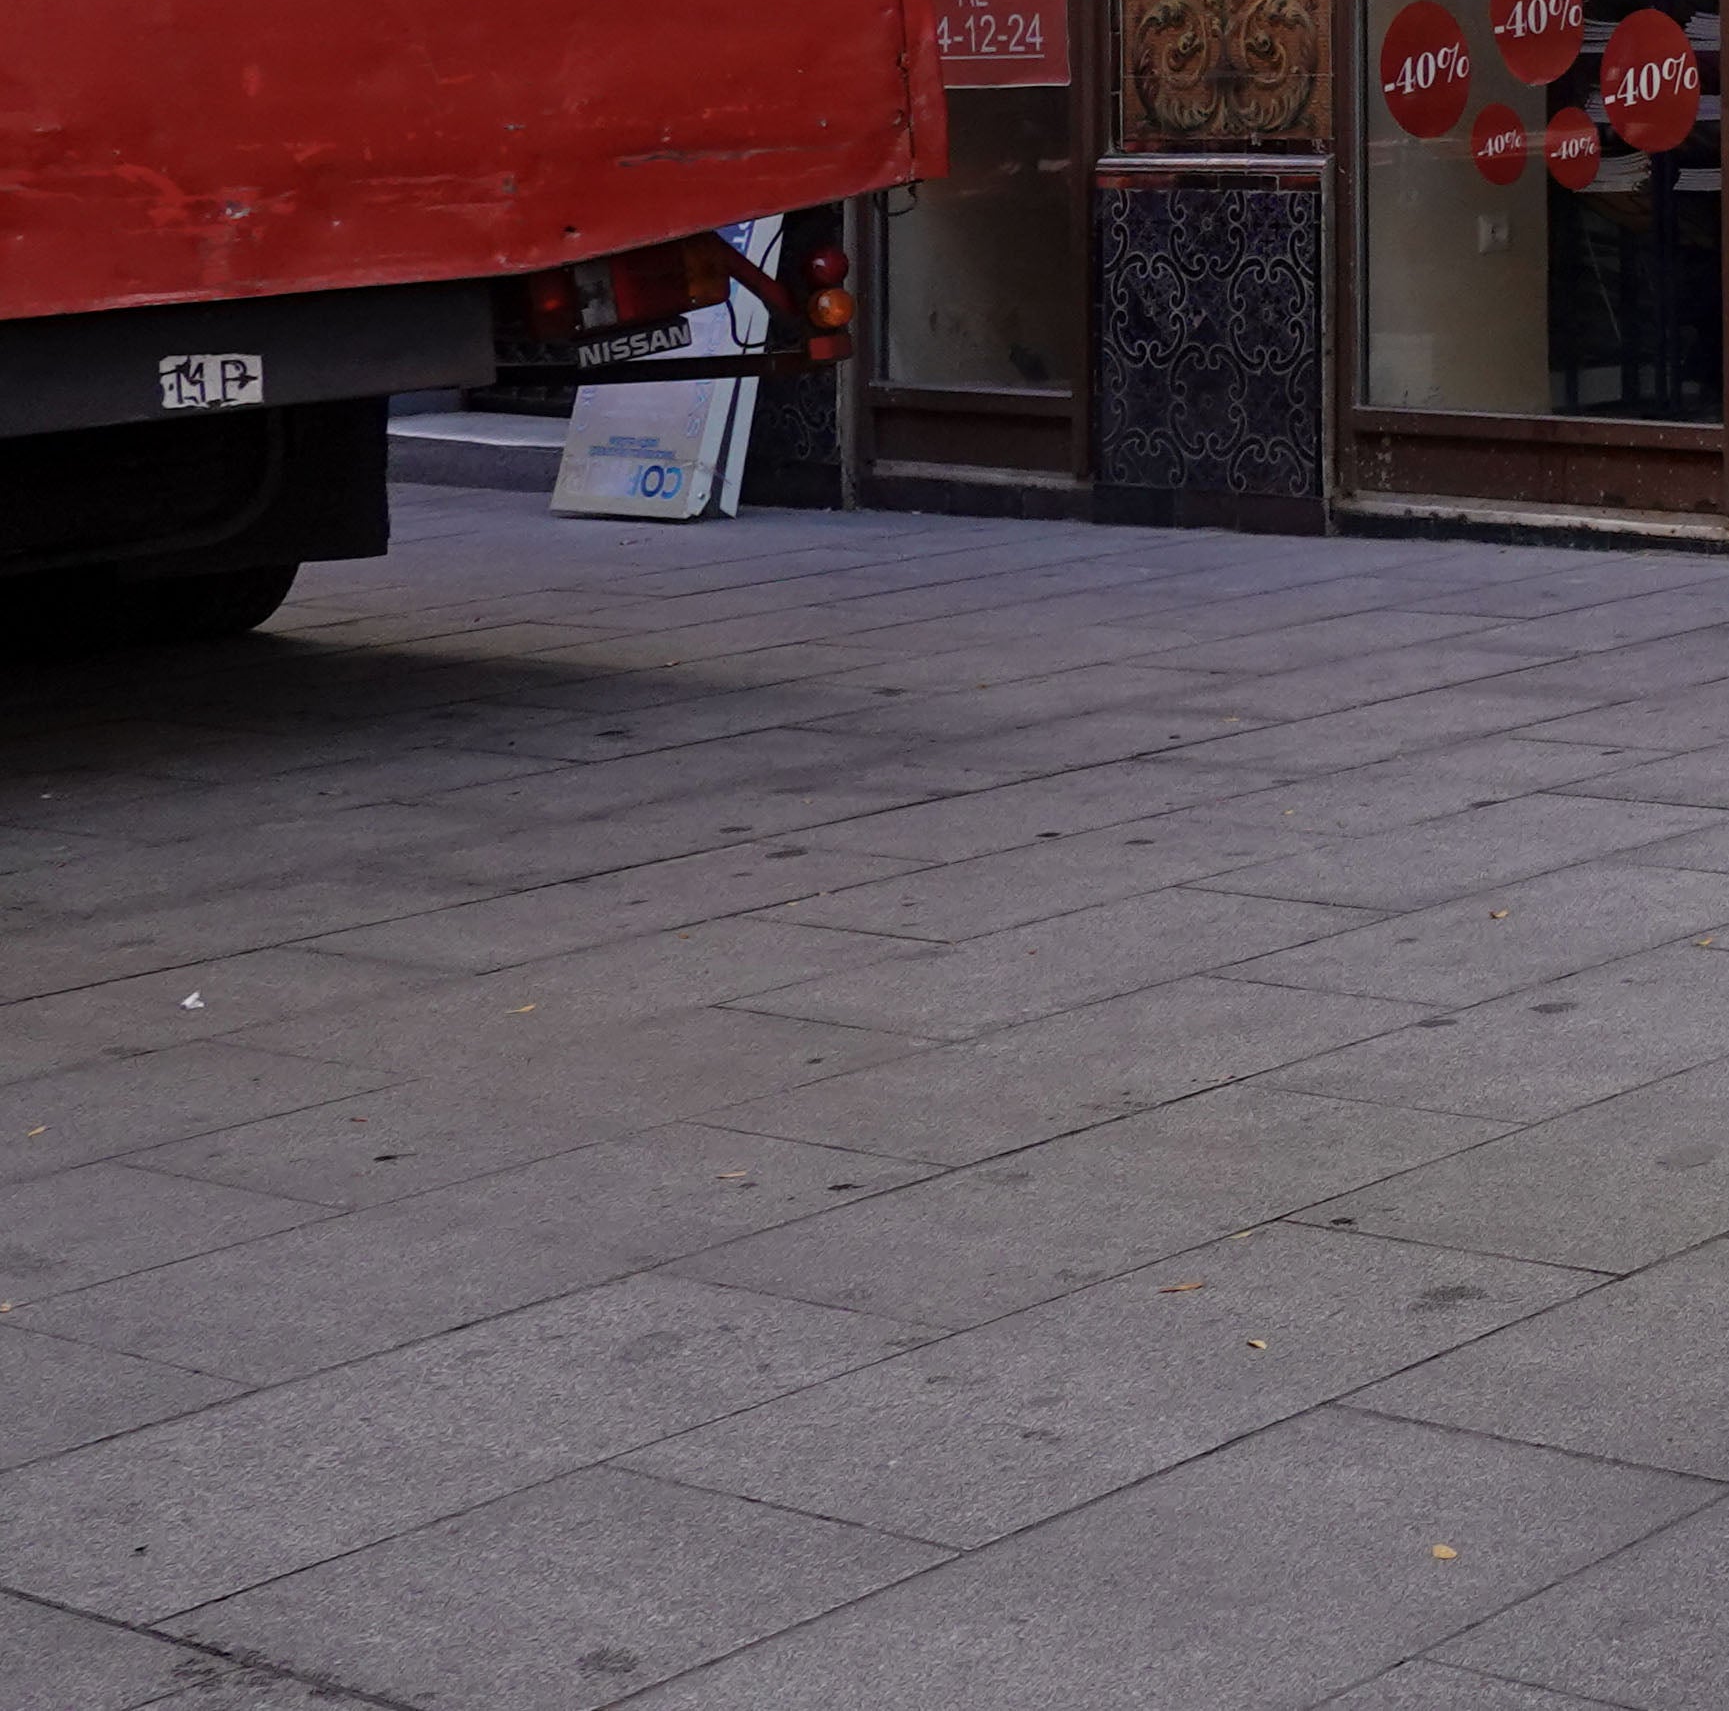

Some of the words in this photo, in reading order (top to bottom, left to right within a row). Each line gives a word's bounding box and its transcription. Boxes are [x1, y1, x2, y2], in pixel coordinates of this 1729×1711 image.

[1383, 42, 1470, 95] -40%
[1603, 52, 1699, 108] -40%
[1476, 129, 1523, 159] -40%
[1550, 137, 1597, 162] -40%
[577, 323, 691, 369] NISSAN
